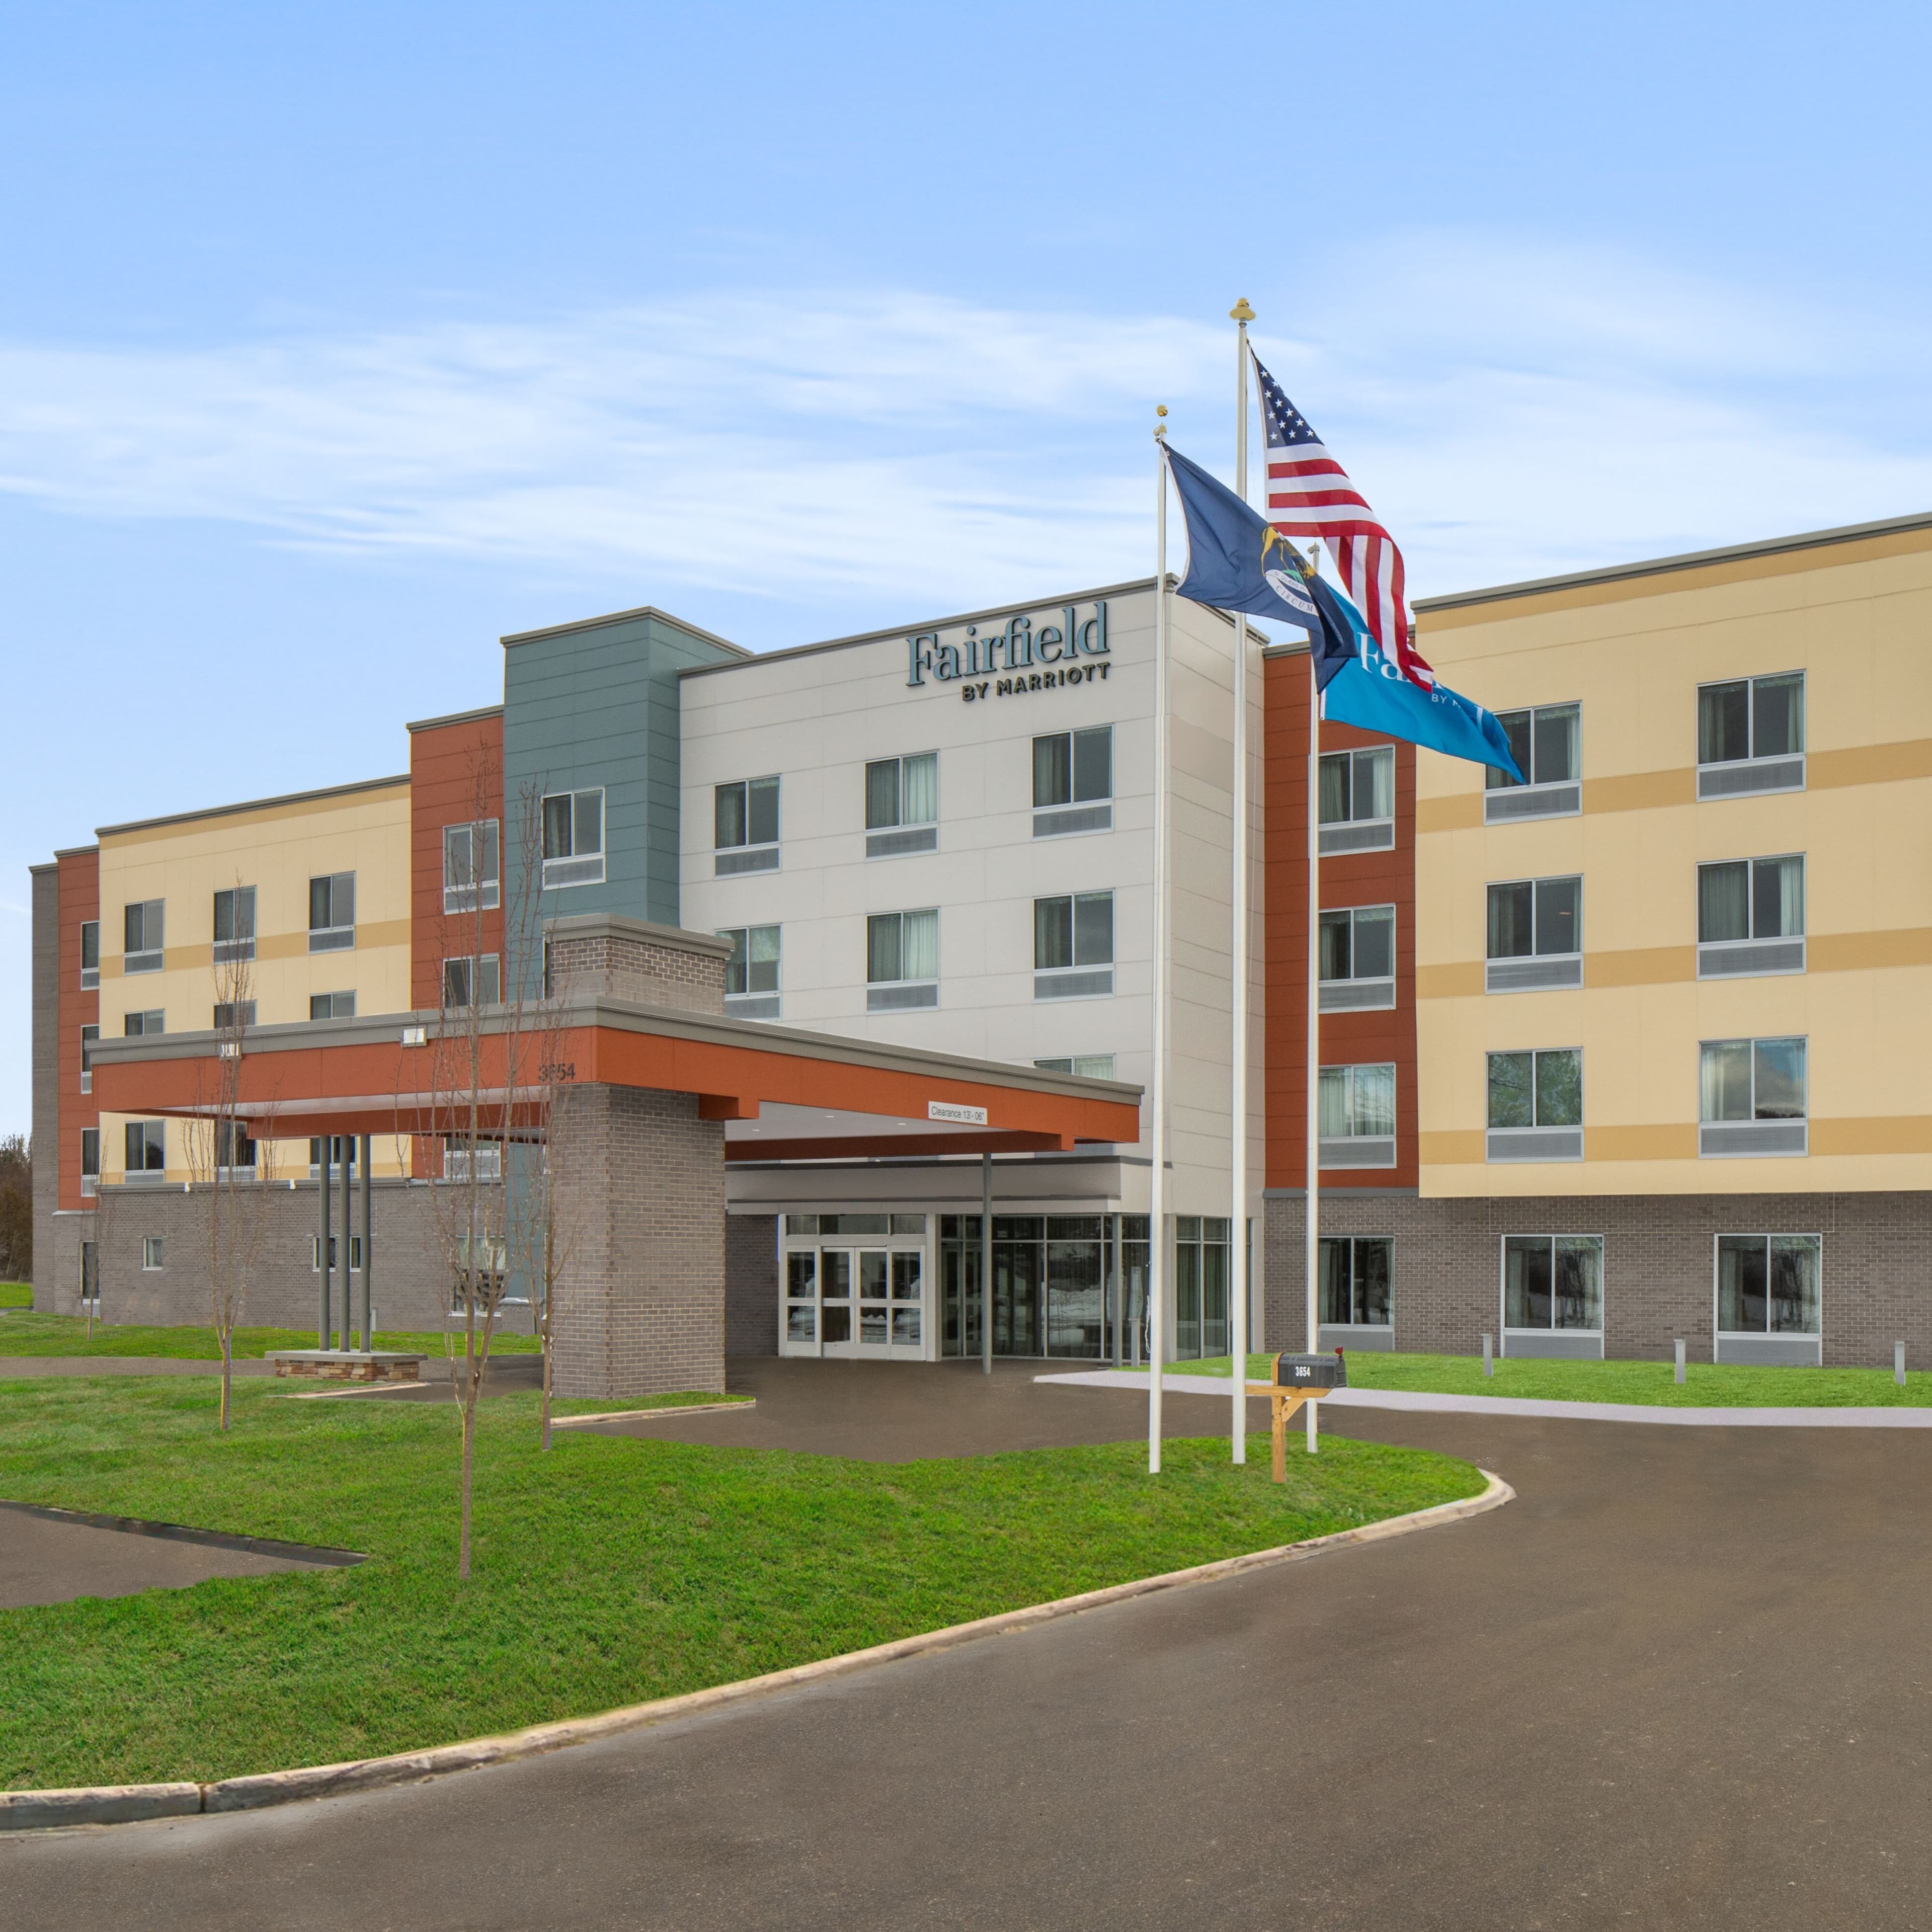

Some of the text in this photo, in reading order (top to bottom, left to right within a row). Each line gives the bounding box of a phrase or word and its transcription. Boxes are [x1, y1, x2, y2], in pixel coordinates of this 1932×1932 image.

[1276, 585, 1314, 612] CIRCUM
[906, 601, 1110, 686] Fairfield
[962, 662, 1110, 701] BY MARRIOTT
[1431, 693, 1447, 704] BY
[931, 1105, 961, 1118] Clearance
[1295, 1366, 1311, 1377] 3654
